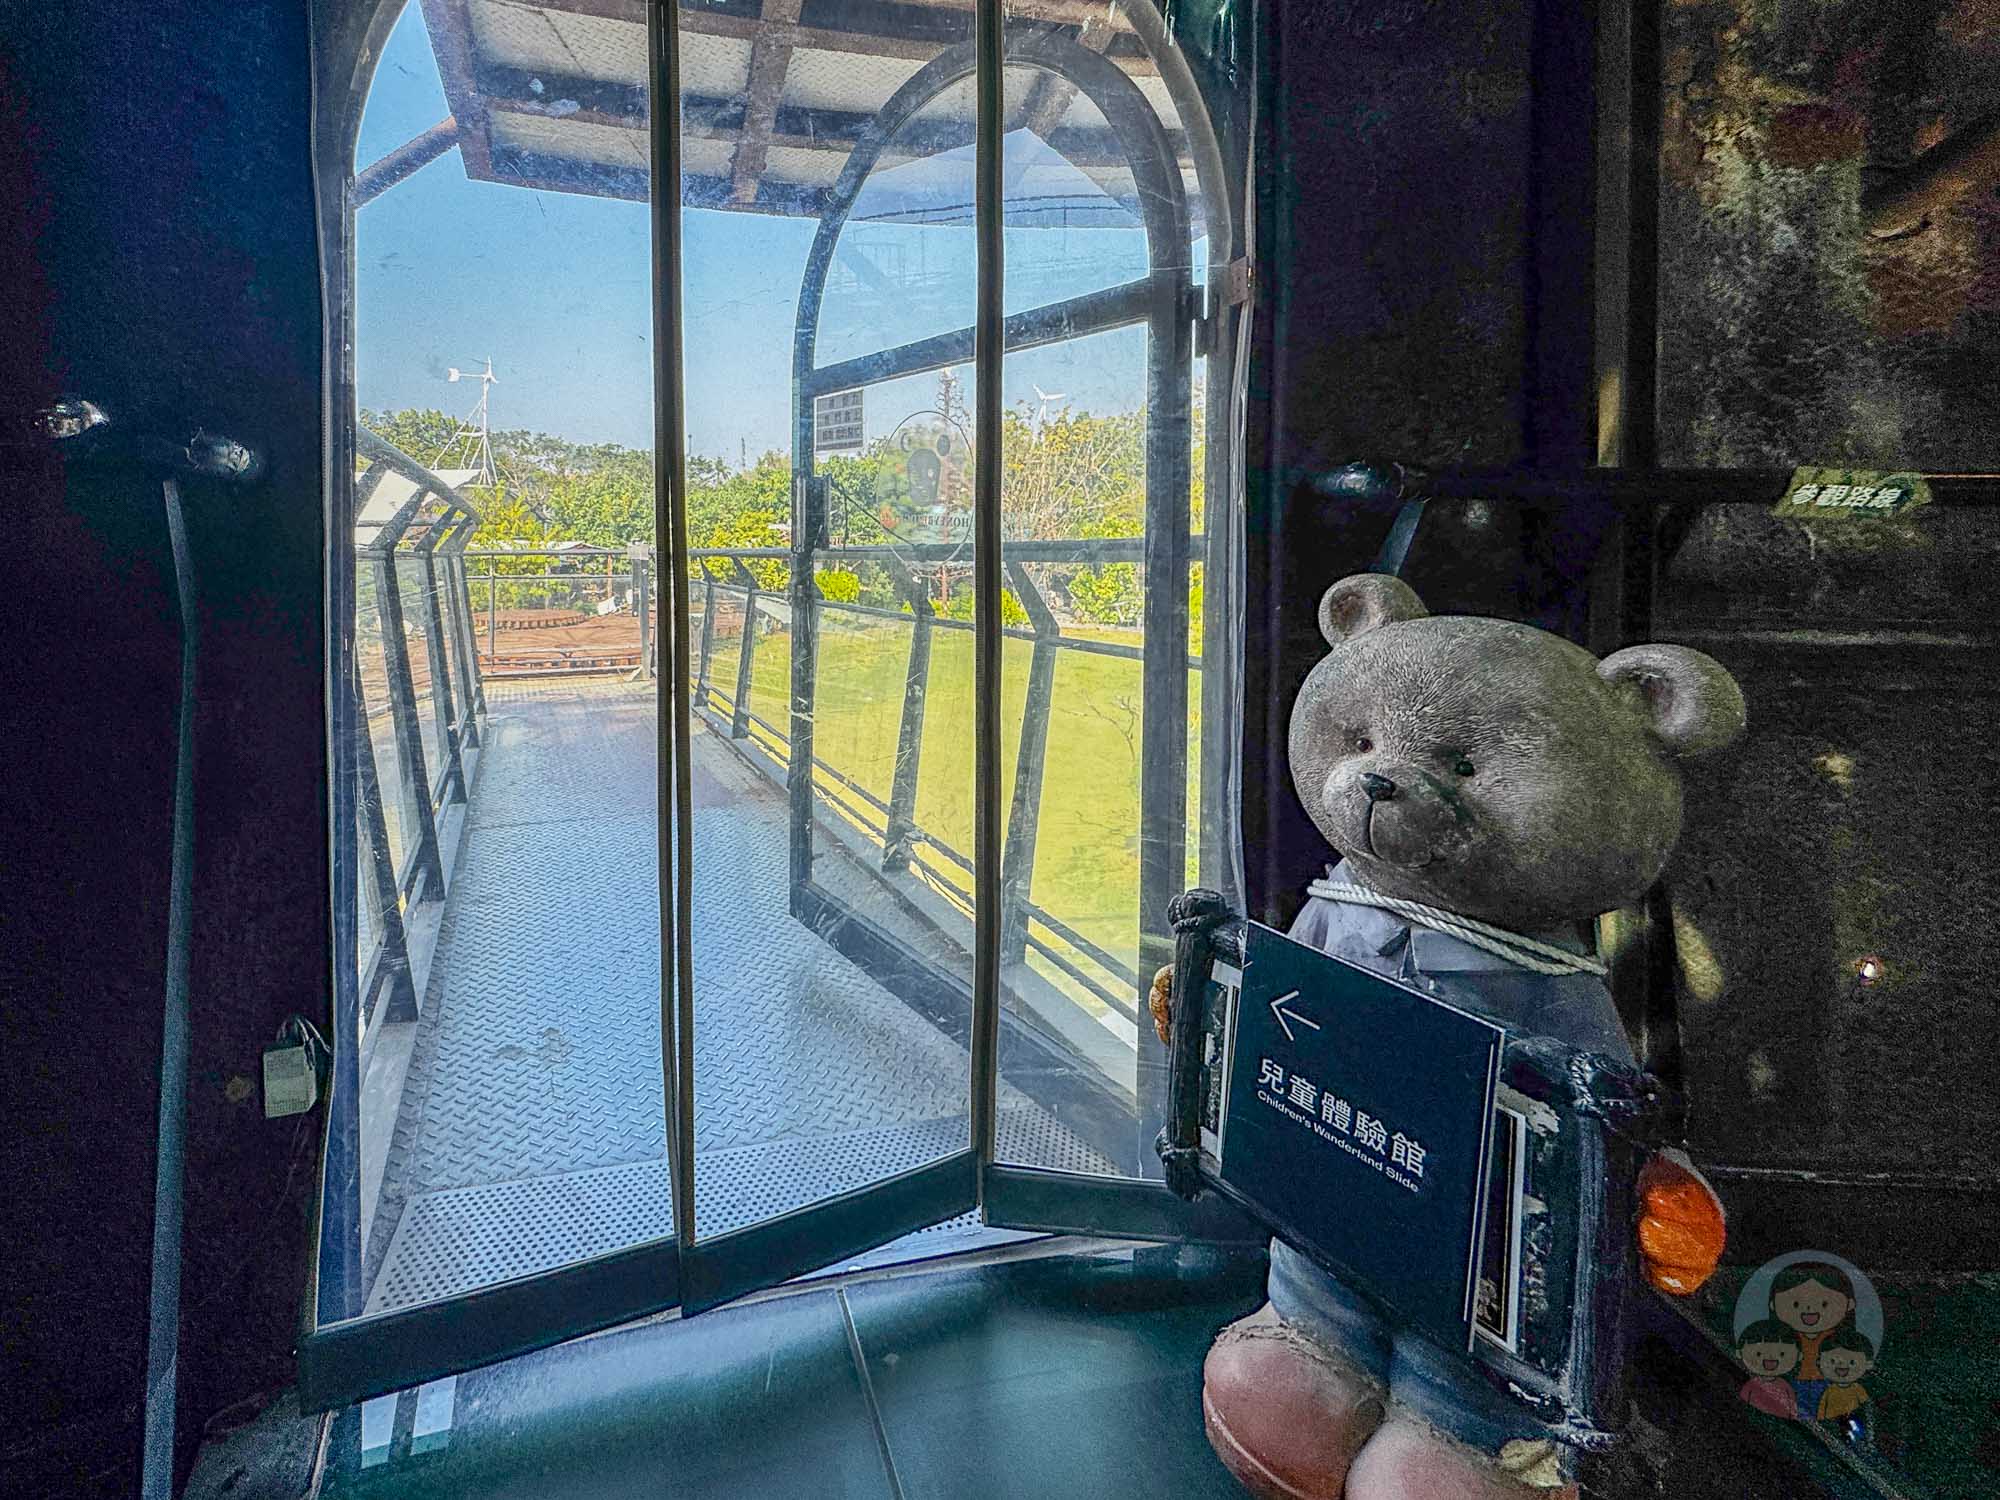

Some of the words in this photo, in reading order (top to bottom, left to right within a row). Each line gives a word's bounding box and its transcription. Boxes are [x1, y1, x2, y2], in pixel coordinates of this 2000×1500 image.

[1791, 483, 1903, 509] 參觀路線
[1257, 1058, 1427, 1178] 兒童體驗館
[1257, 1089, 1312, 1128] Children's
[1313, 1122, 1383, 1171] Wanderland
[1385, 1166, 1419, 1193] Slide
